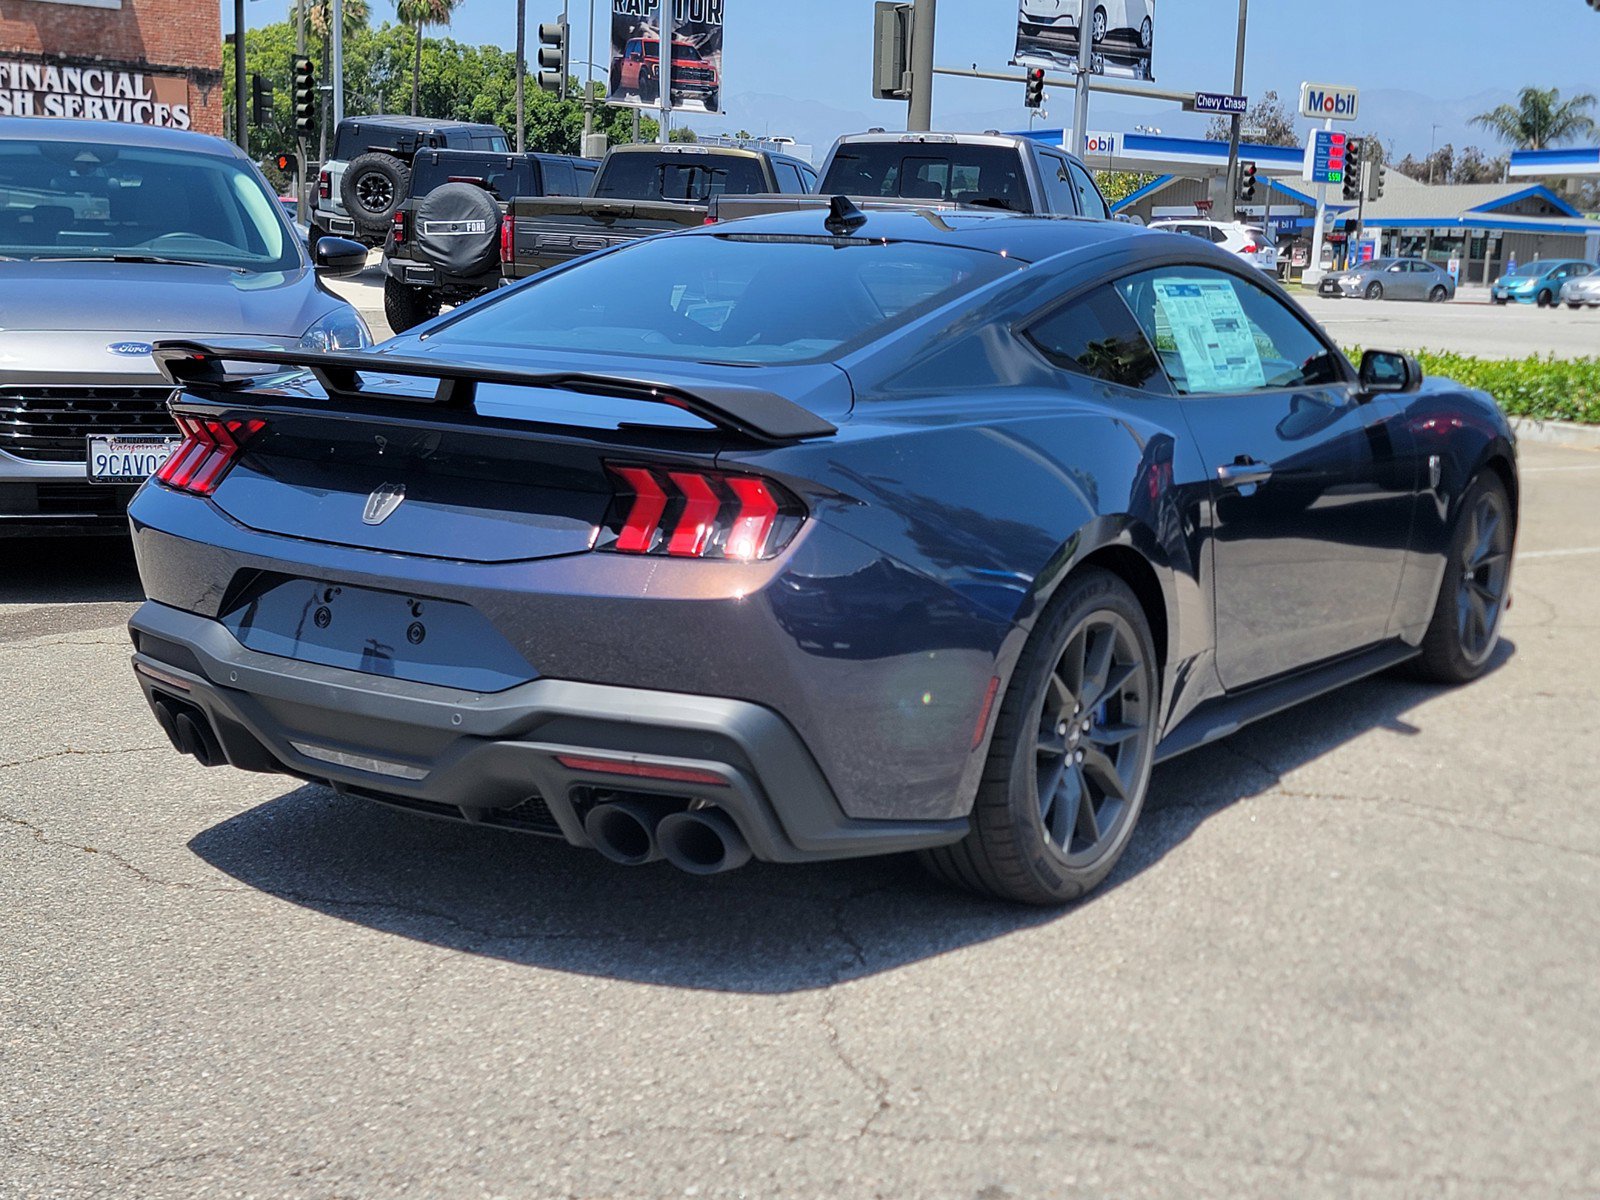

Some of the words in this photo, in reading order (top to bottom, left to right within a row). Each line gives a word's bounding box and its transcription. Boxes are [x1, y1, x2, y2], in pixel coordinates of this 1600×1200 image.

[0, 62, 153, 100] FINANCIAL
[44, 93, 191, 130] SERVICES
[1197, 94, 1221, 110] Chevy
[1223, 96, 1246, 109] Chase
[1308, 91, 1355, 114] Mobil
[1085, 135, 1114, 152] obil
[466, 222, 486, 232] FORD
[119, 343, 148, 353] Ford
[96, 454, 167, 476] 9CAV0
